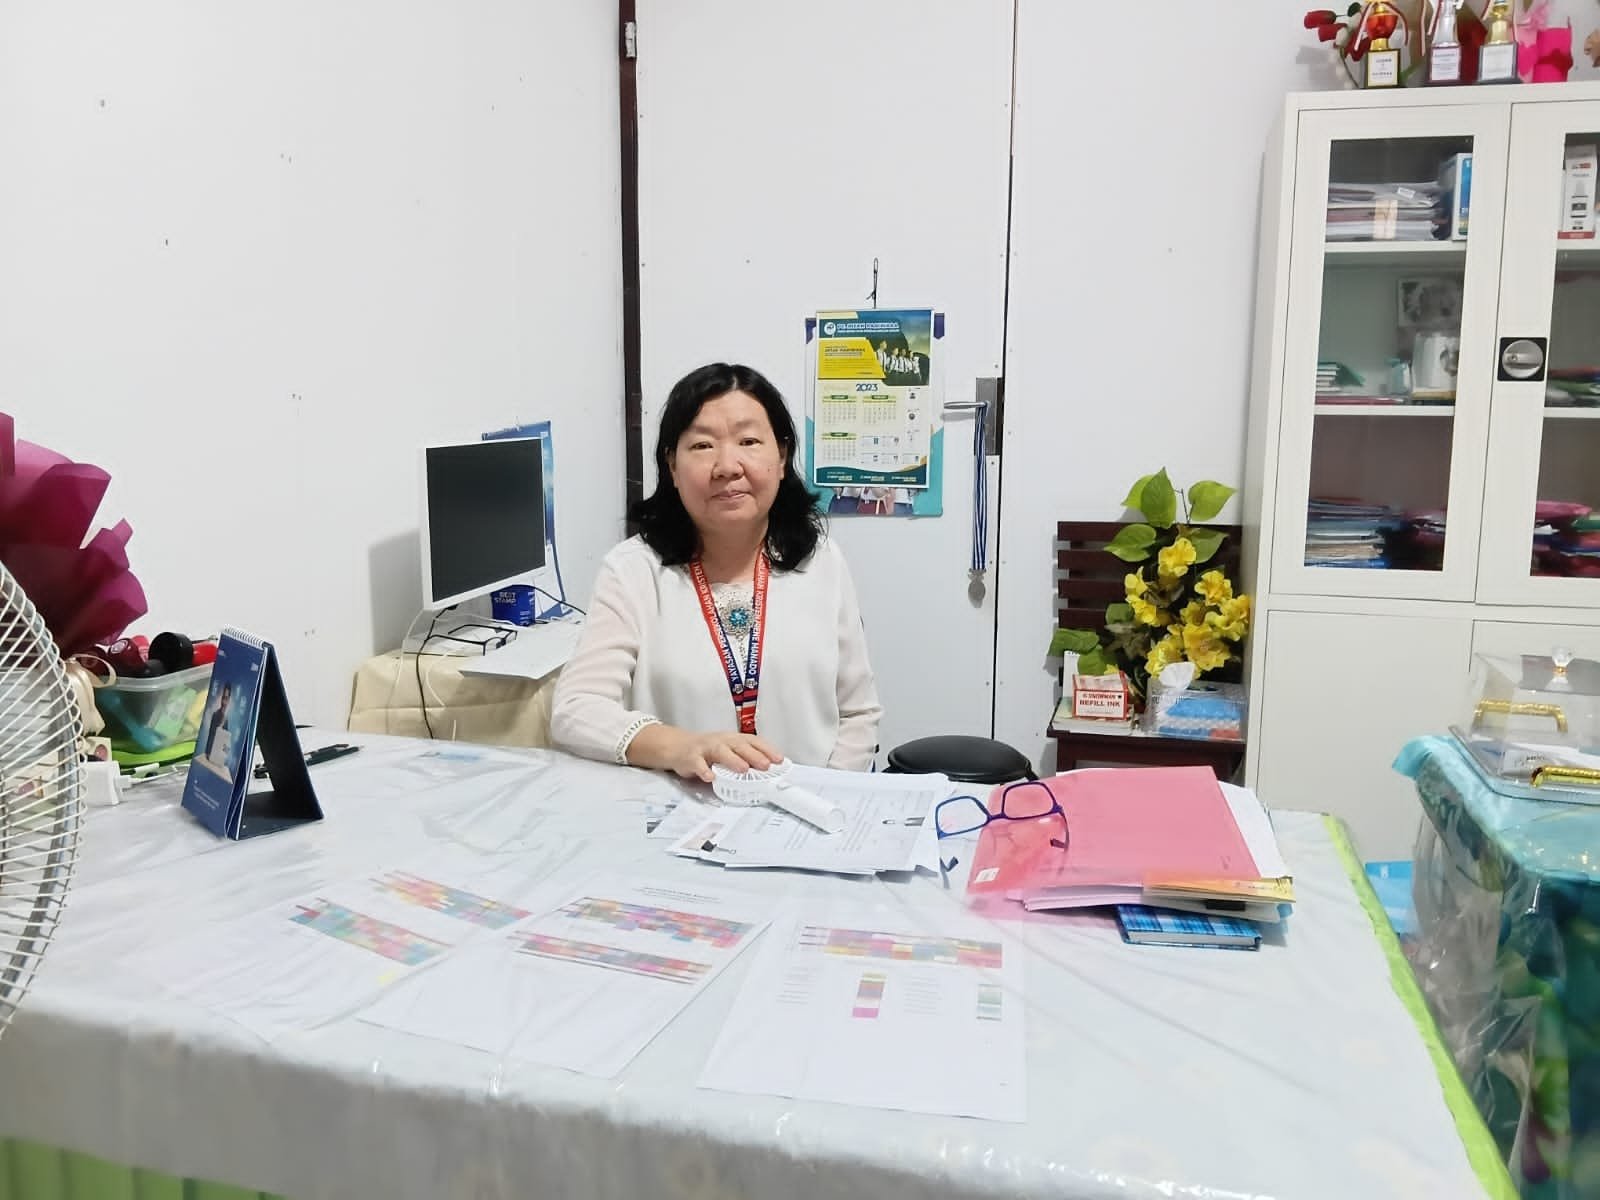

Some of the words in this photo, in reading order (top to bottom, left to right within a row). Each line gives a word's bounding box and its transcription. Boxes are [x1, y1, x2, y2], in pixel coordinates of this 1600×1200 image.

[856, 383, 878, 391] 2023
[723, 648, 740, 683] YAYASAN
[748, 642, 759, 675] MANADO
[1079, 699, 1105, 707] REFILL
